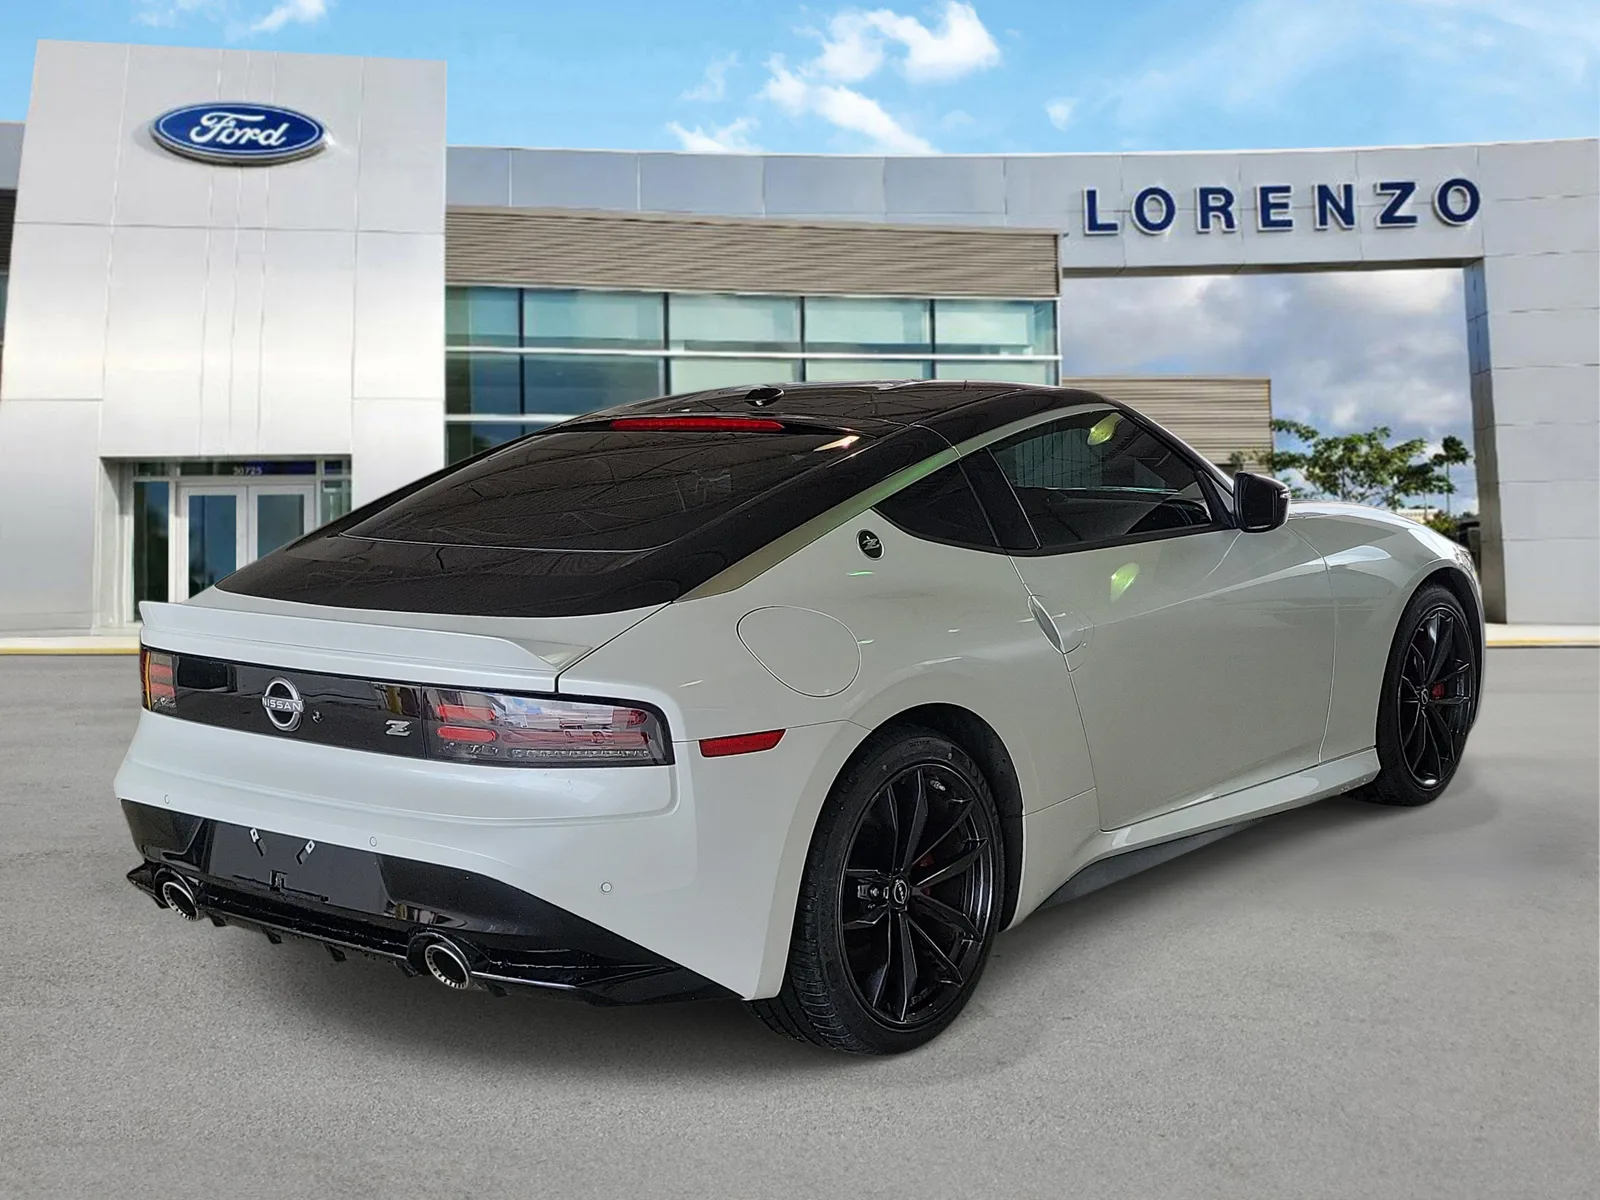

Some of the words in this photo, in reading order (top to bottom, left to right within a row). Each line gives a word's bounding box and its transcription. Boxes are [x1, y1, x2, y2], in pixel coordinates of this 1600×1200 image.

[189, 111, 290, 146] Ford
[1084, 177, 1482, 235] LORENZO
[262, 697, 302, 711] NISSAN
[385, 719, 411, 736] Z
